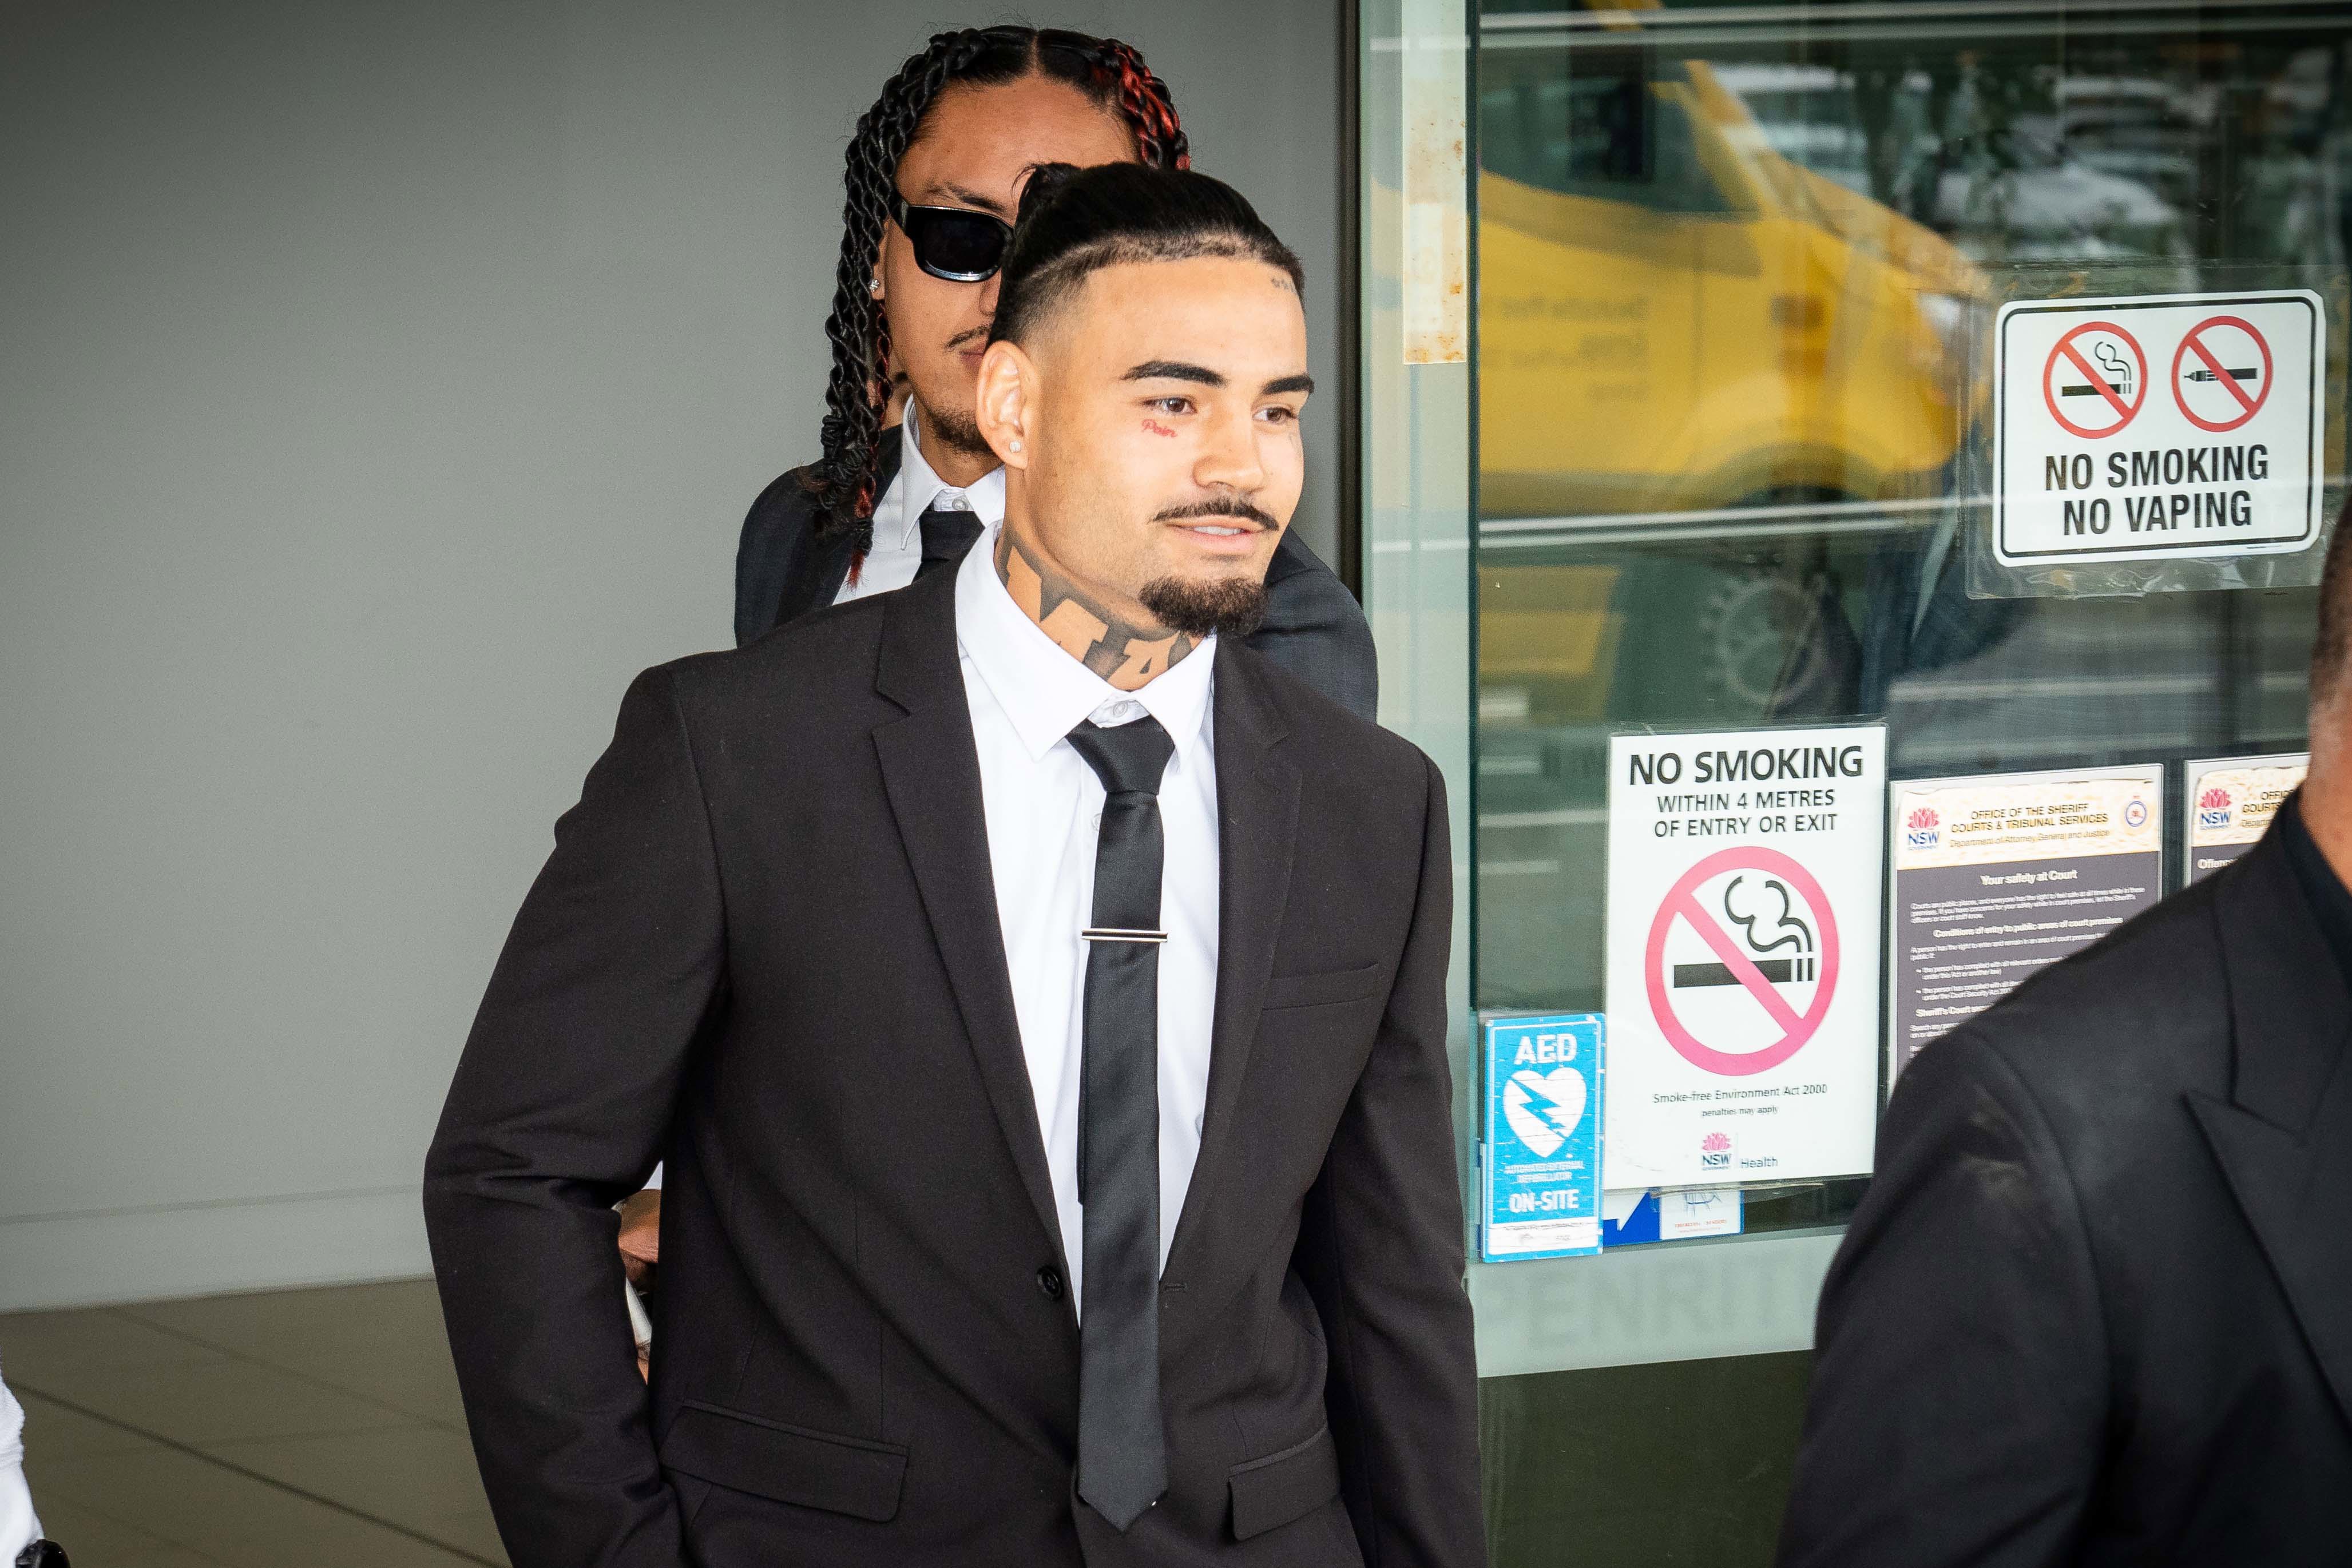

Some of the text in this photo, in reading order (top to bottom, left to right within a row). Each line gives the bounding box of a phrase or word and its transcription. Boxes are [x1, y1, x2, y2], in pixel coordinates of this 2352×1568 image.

[2045, 444, 2269, 491] NO SMOKING
[2063, 490, 2252, 536] NO VAPING
[1630, 745, 1863, 785] NO SMOKING
[1657, 789, 1835, 813] WITHIN 4 METRES
[1971, 803, 2089, 820] OFFICE OF THE SHERIFF
[2200, 811, 2231, 824] NSW
[1655, 813, 1838, 837] OF ENTRY OR EXIT
[1951, 813, 2108, 833] COURTS & TRIBUNAL SERVICES
[1909, 831, 1939, 845] NSW
[1980, 869, 2078, 886] Your safety at Court
[1513, 1033, 1577, 1065] AED
[1653, 1084, 1828, 1103] Smoke-free Environment Act 2000
[1702, 1105, 1779, 1117] penalties may apply
[1702, 1153, 1778, 1168] NSW Health
[1509, 1189, 1579, 1213] ON-SITE
